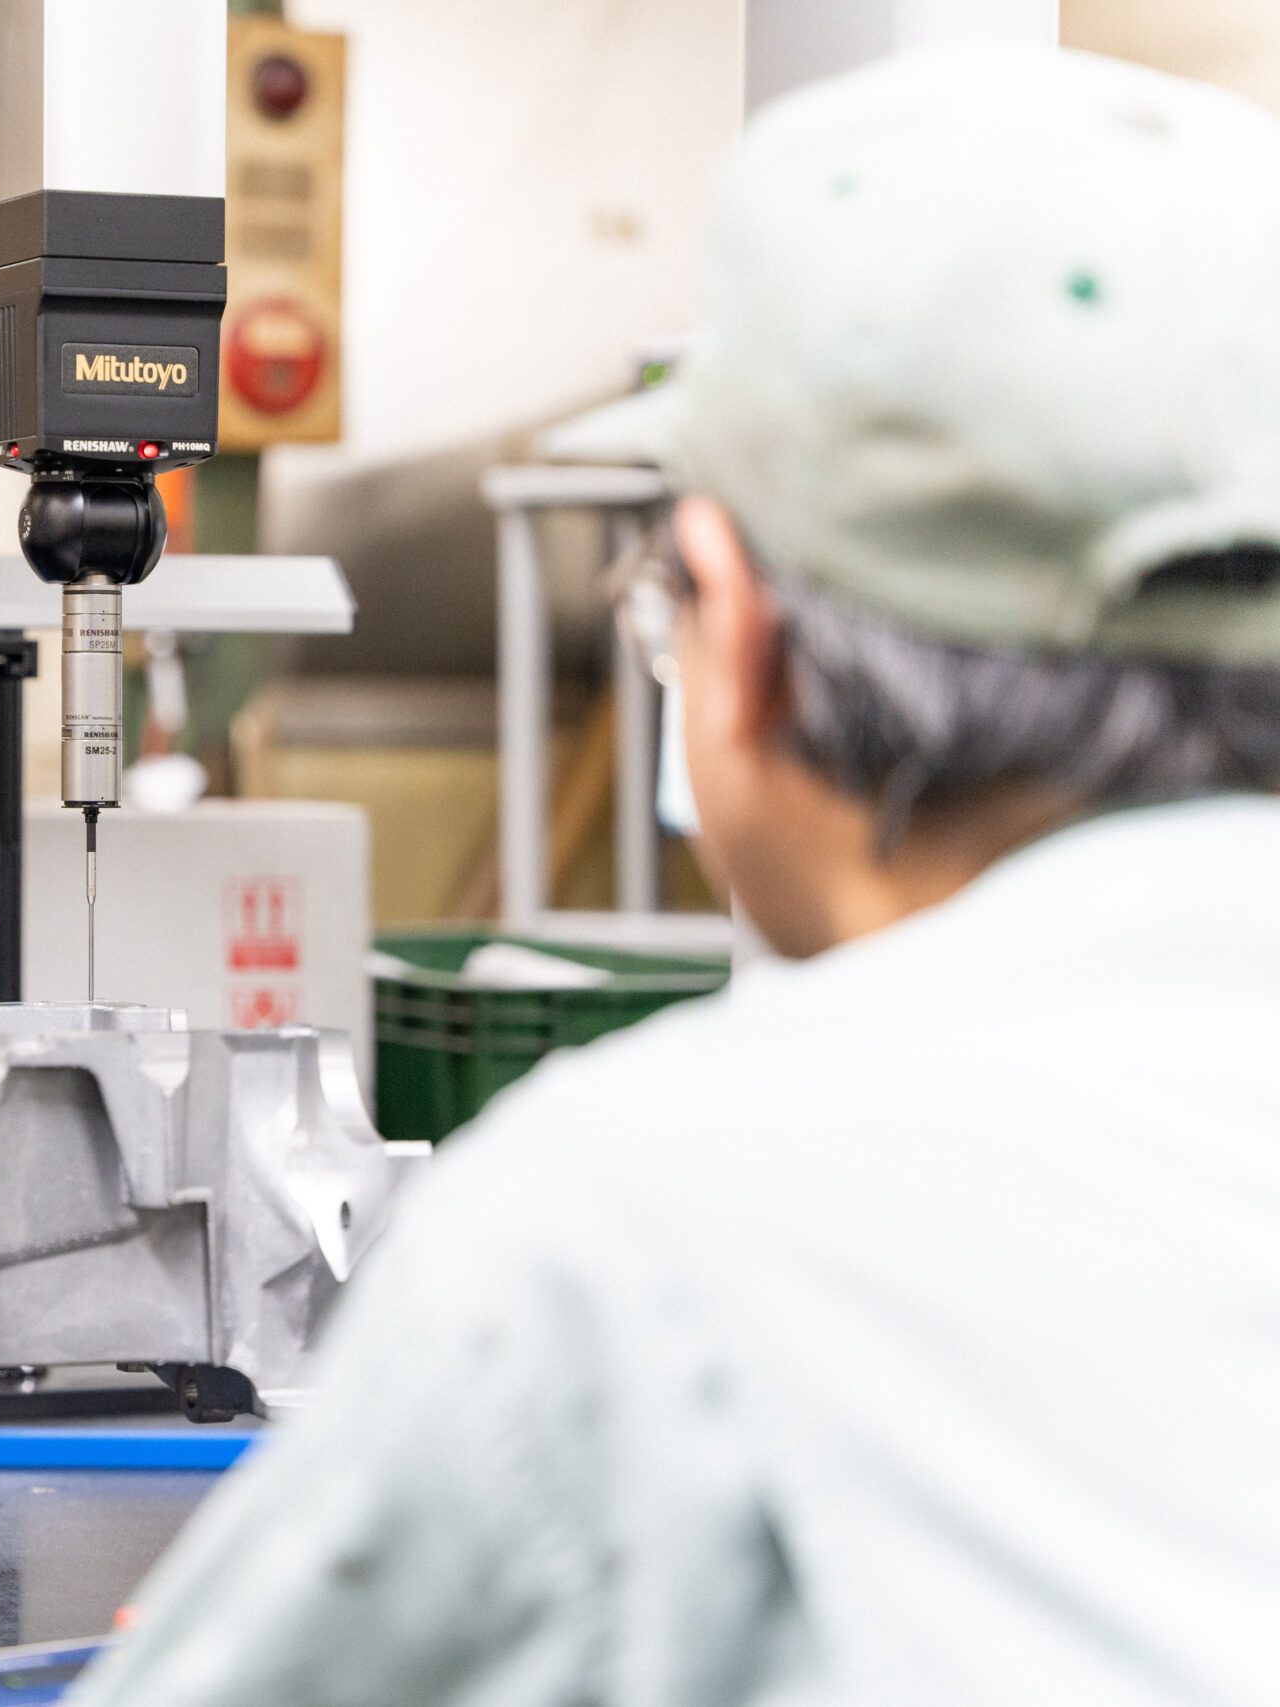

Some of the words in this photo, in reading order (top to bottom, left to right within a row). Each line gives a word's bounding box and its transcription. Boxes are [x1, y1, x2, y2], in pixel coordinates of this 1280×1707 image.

[75, 353, 187, 390] Mitutoyo
[172, 442, 211, 452] PH10MQ
[80, 629, 119, 637] RENISHAW
[89, 640, 116, 649] SP25M
